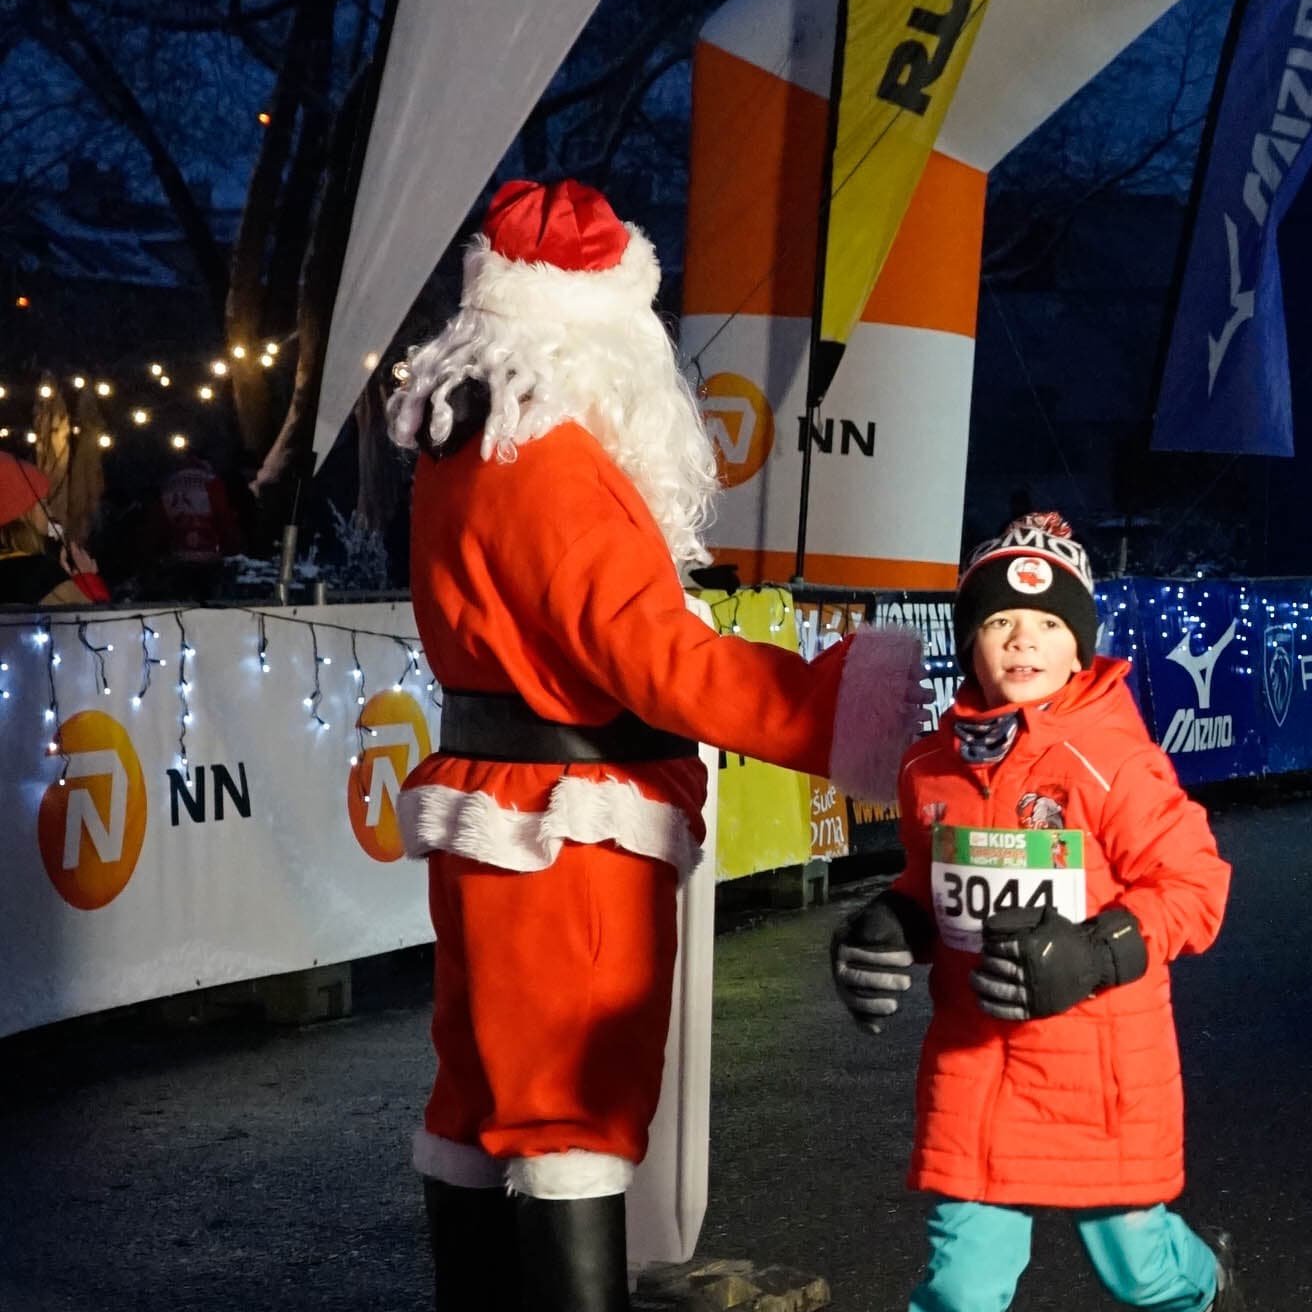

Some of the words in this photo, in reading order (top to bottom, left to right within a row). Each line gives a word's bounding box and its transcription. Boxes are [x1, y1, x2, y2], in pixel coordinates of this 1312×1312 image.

[798, 415, 876, 457] NN
[167, 761, 252, 827] NN
[988, 833, 1027, 848] KIDS
[944, 873, 1054, 920] 3044
